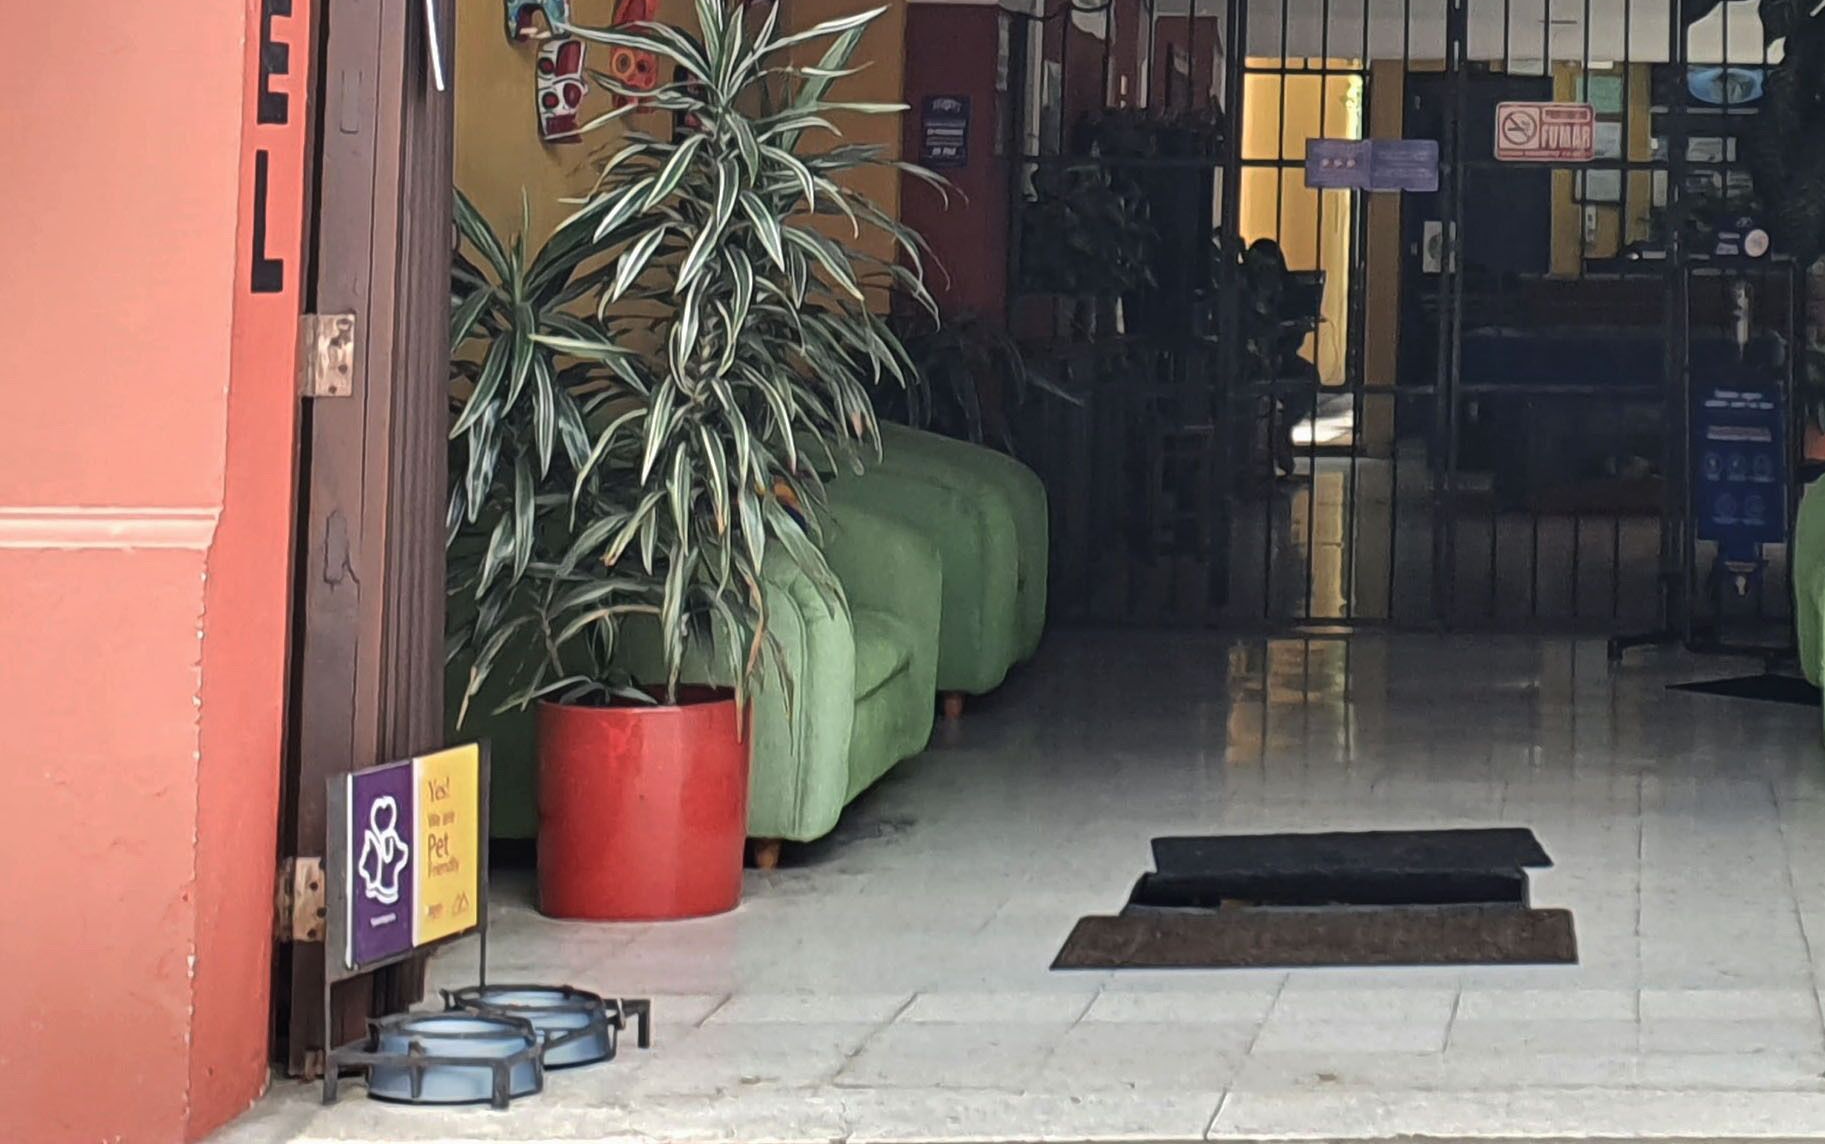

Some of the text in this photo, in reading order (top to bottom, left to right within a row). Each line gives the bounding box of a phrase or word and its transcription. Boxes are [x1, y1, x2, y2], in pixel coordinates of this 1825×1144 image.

[1541, 125, 1591, 149] FUMAR
[427, 776, 451, 803] Yes!
[427, 832, 449, 860] Pet
